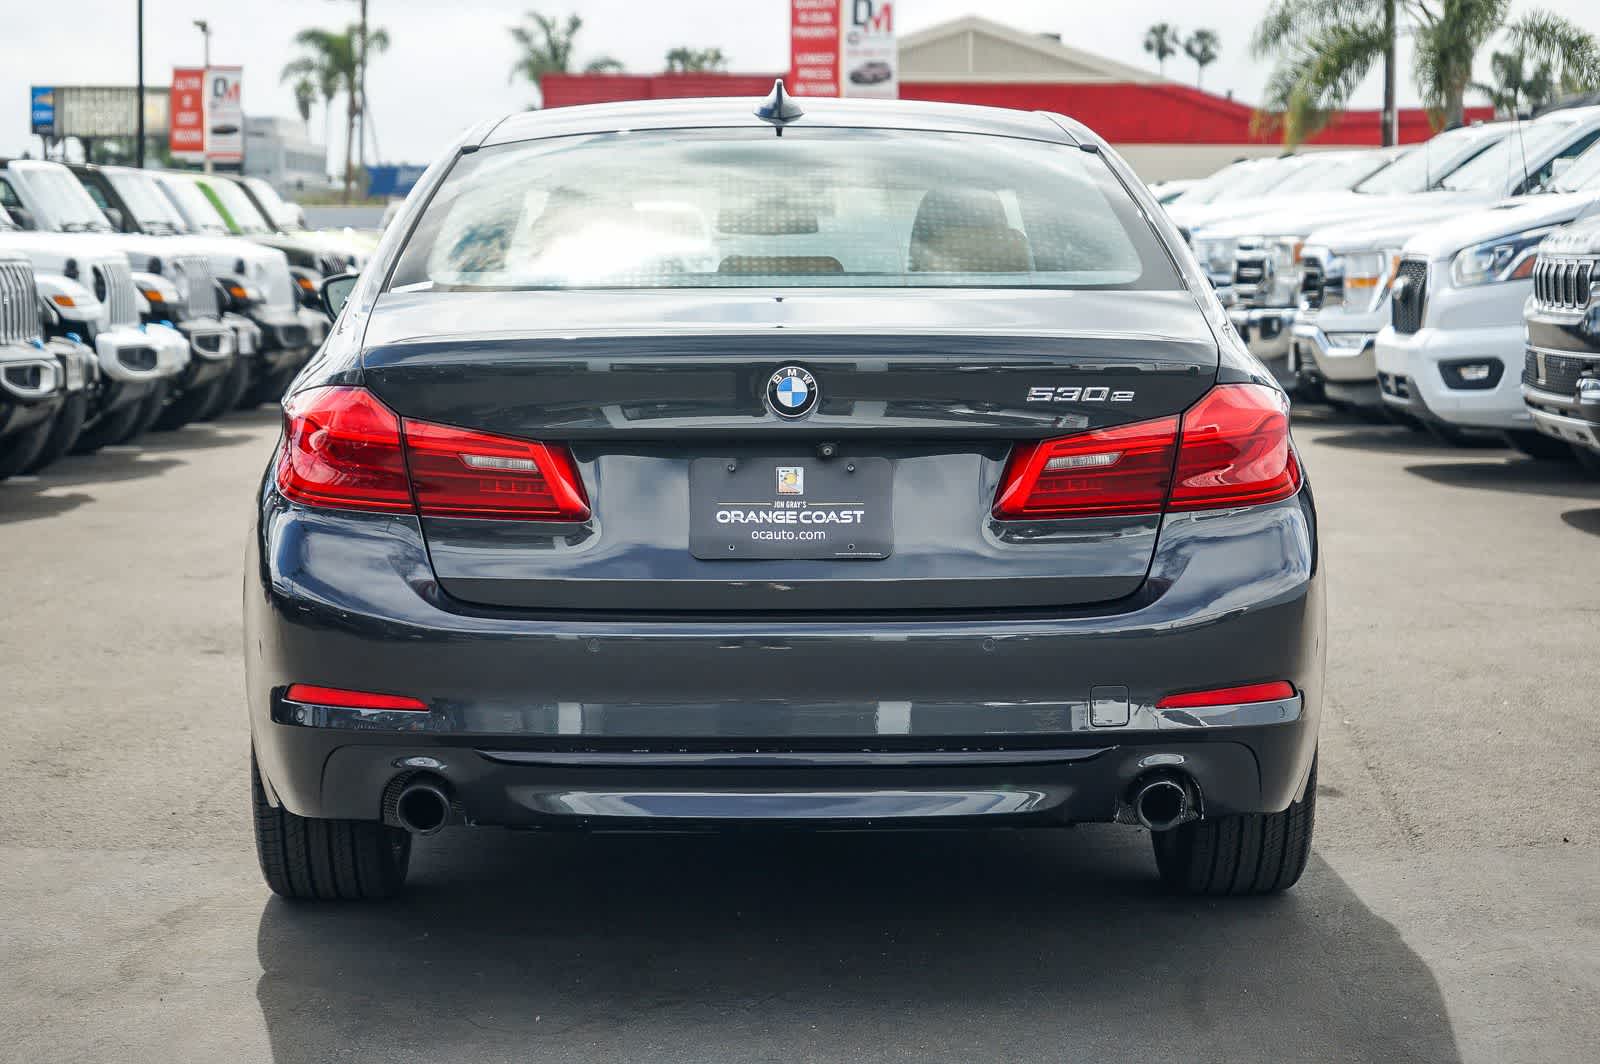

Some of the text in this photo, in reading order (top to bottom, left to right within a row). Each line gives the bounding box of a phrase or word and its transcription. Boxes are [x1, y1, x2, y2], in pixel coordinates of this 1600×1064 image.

[772, 369, 812, 384] BMW
[1026, 387, 1135, 402] 530e
[716, 510, 865, 524] ORANGE COAST
[751, 530, 826, 540] ocauto.com
